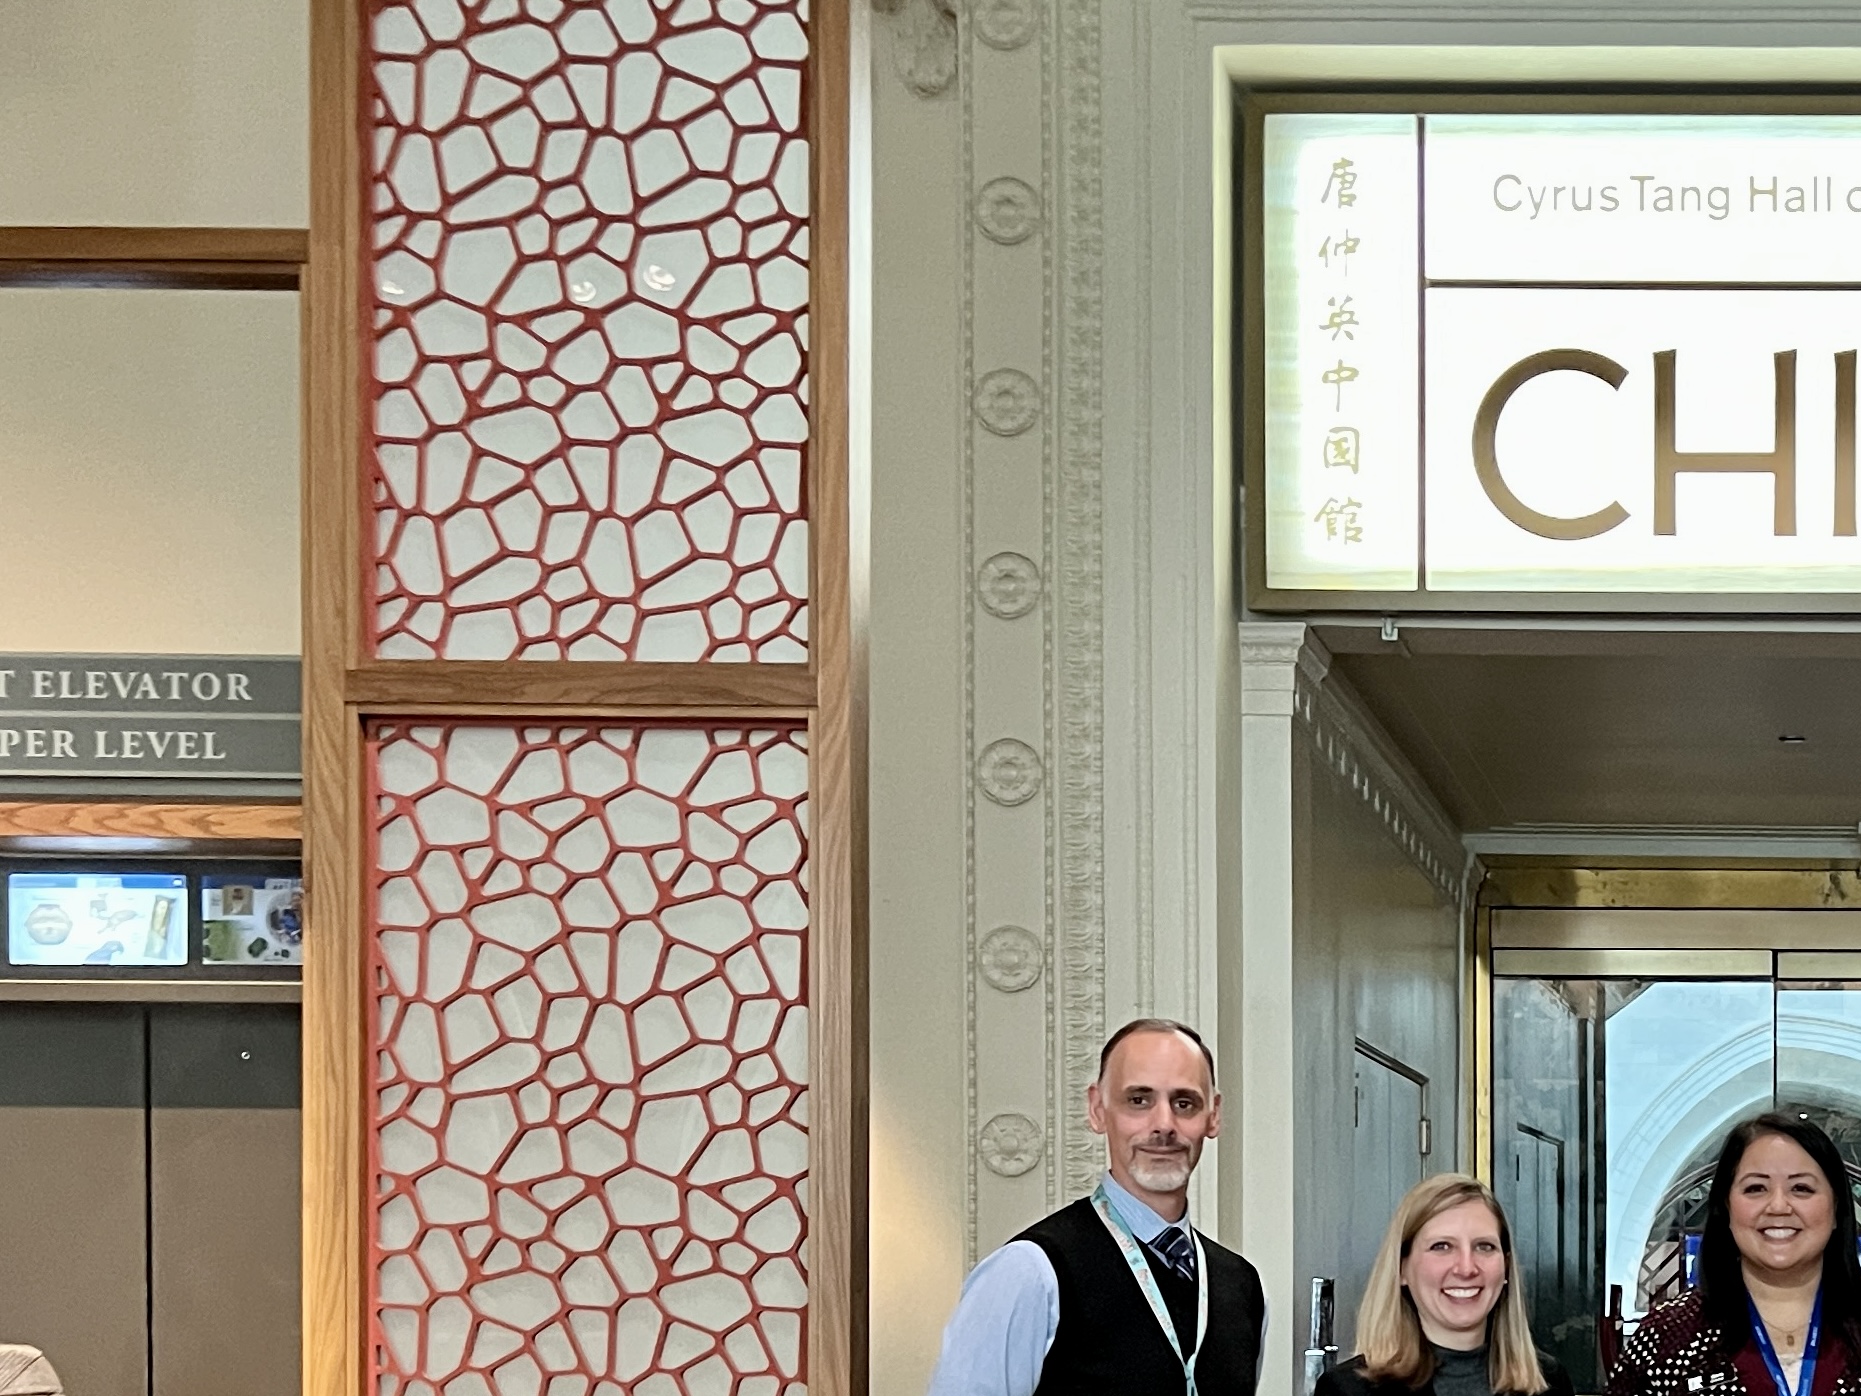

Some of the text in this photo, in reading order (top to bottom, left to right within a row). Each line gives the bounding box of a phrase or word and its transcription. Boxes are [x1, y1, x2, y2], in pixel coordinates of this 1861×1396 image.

[1492, 173, 1621, 220] Cyrus
[1628, 173, 1730, 220] Tang
[1749, 173, 1833, 215] Hall
[31, 669, 253, 701] ELEVATOR
[94, 730, 227, 760] LEVEL
